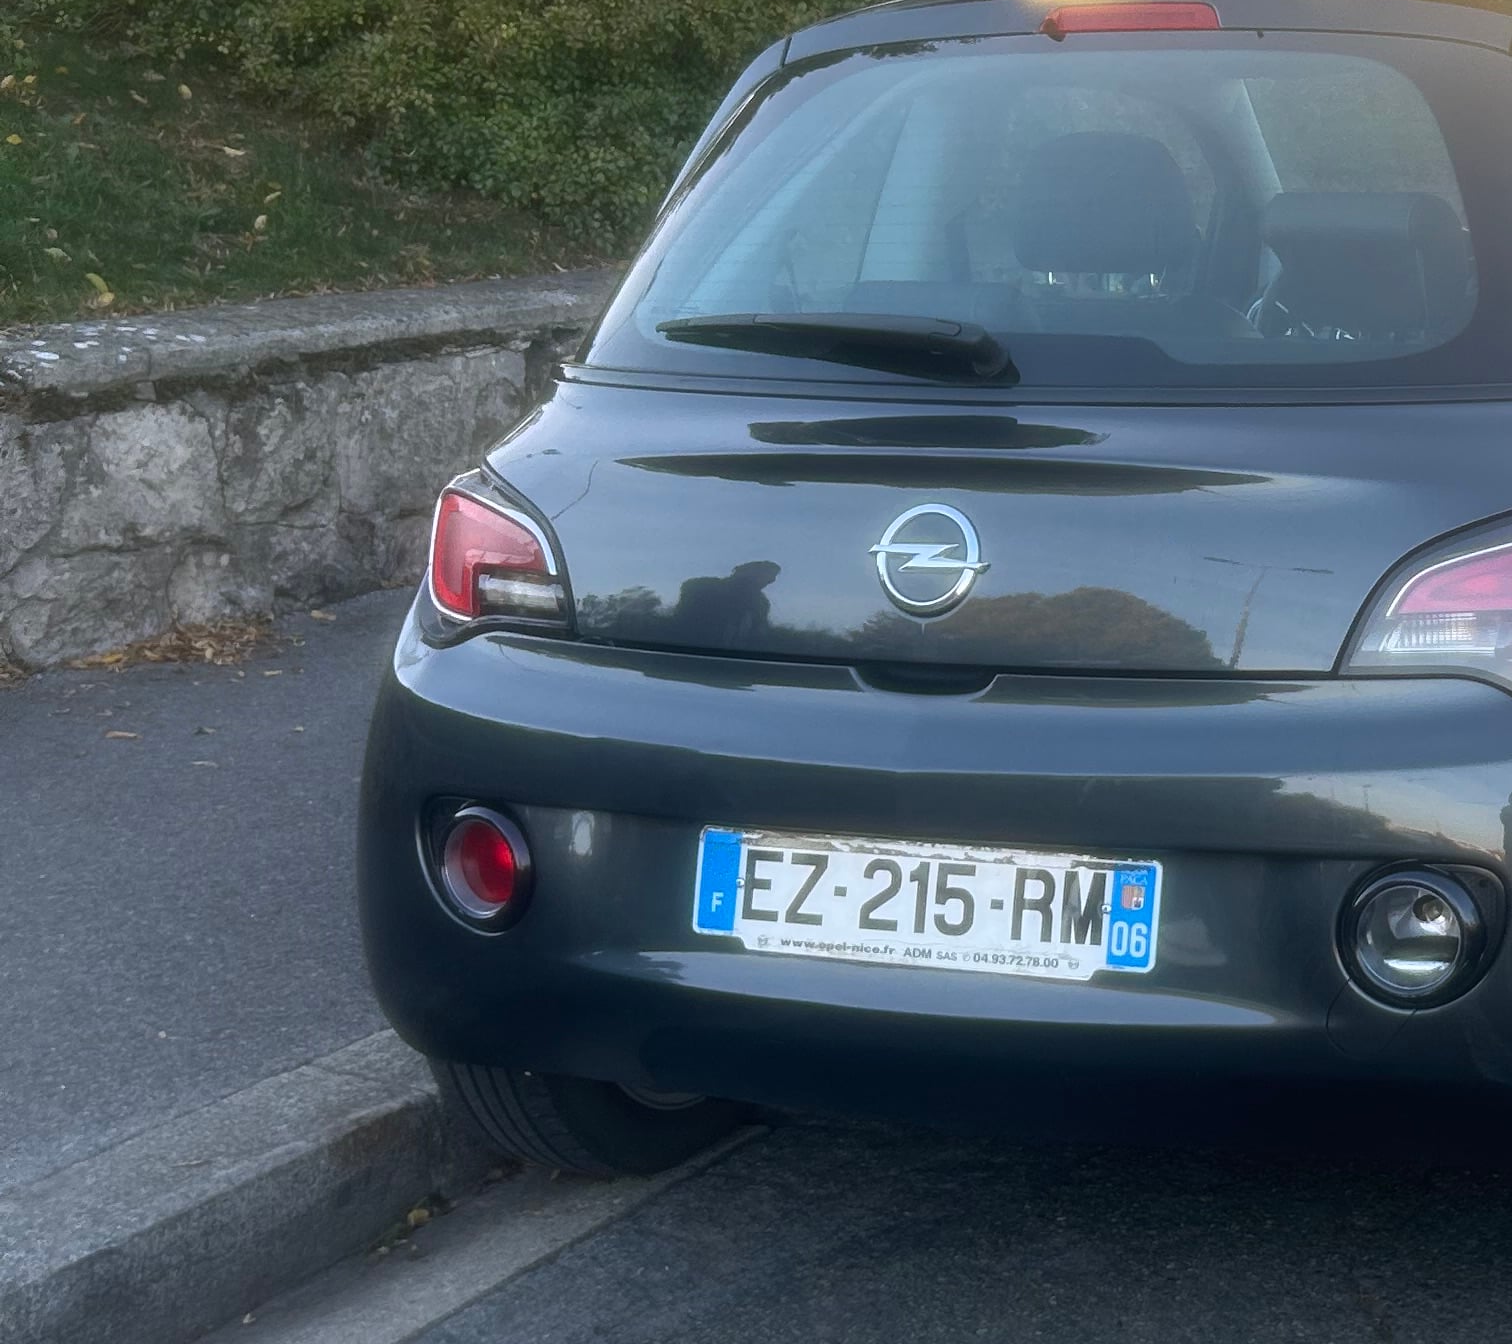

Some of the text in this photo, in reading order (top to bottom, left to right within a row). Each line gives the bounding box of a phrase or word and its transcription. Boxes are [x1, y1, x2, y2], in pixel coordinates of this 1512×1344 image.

[711, 891, 725, 913] F
[741, 848, 1107, 947] EZ-215-RM
[780, 938, 1059, 968] www.opel-nice.fr ADM SAS 04.93.72.78.00
[1111, 920, 1148, 958] 06
